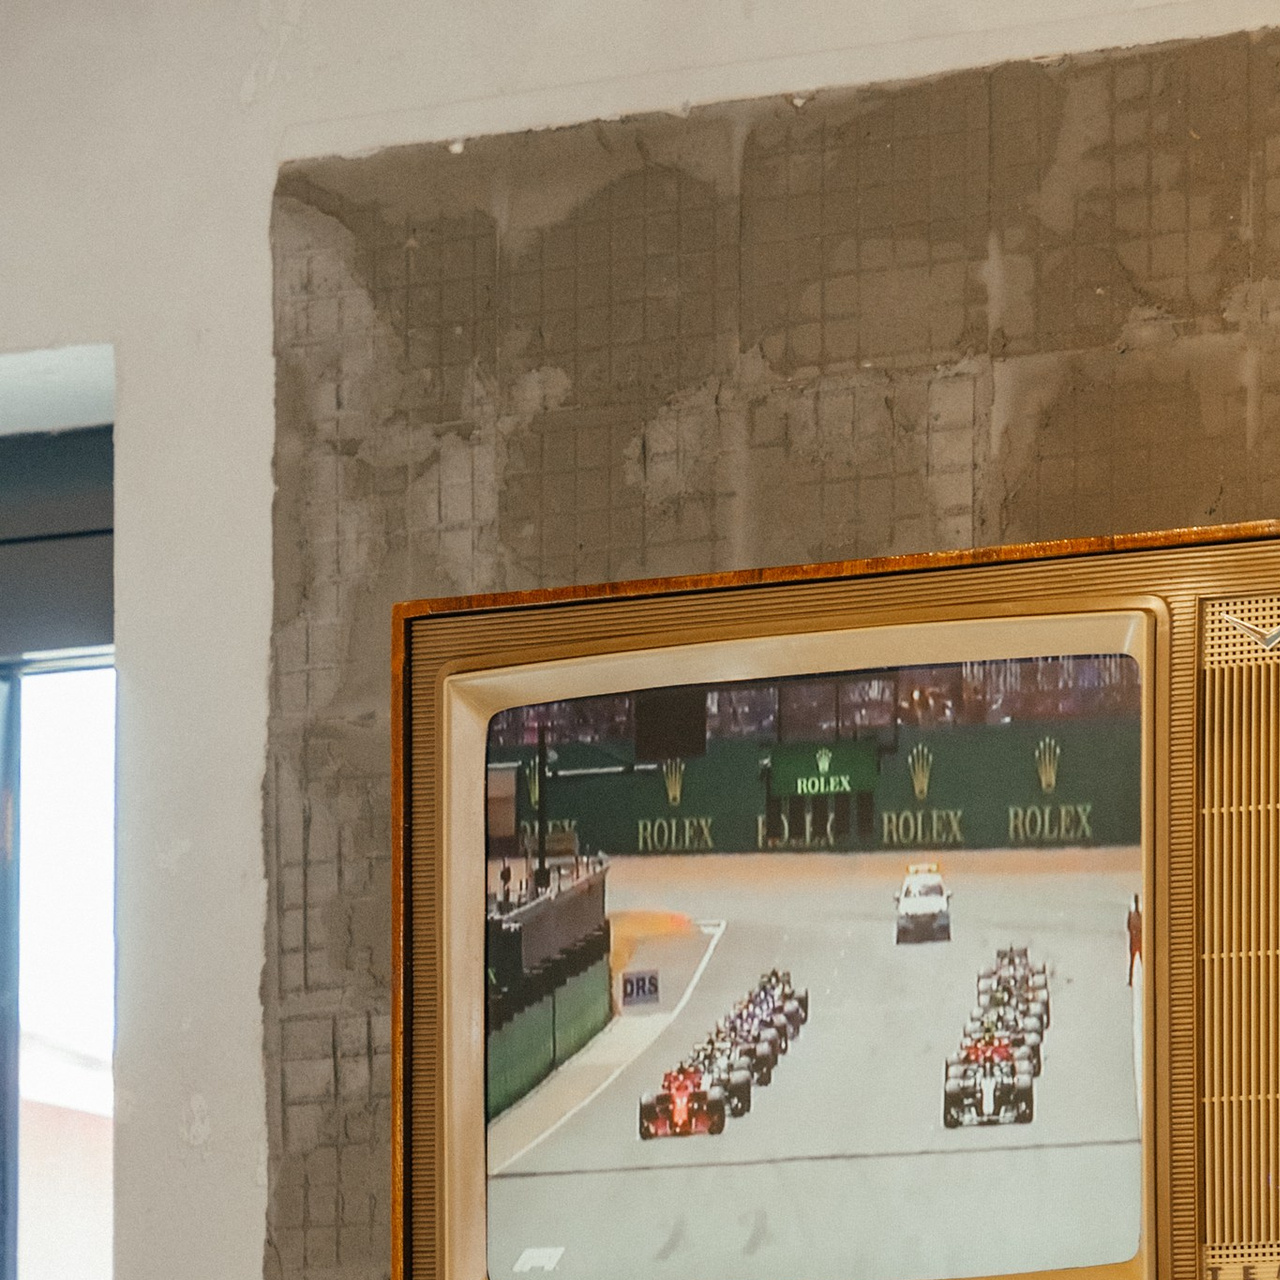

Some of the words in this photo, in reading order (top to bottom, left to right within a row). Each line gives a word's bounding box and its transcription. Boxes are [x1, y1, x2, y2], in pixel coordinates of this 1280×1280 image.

[797, 775, 851, 795] ROLEX
[638, 818, 714, 851] ROLEX
[882, 810, 964, 844] ROLEX
[1008, 804, 1094, 841] ROLEX
[623, 975, 659, 998] DRS
